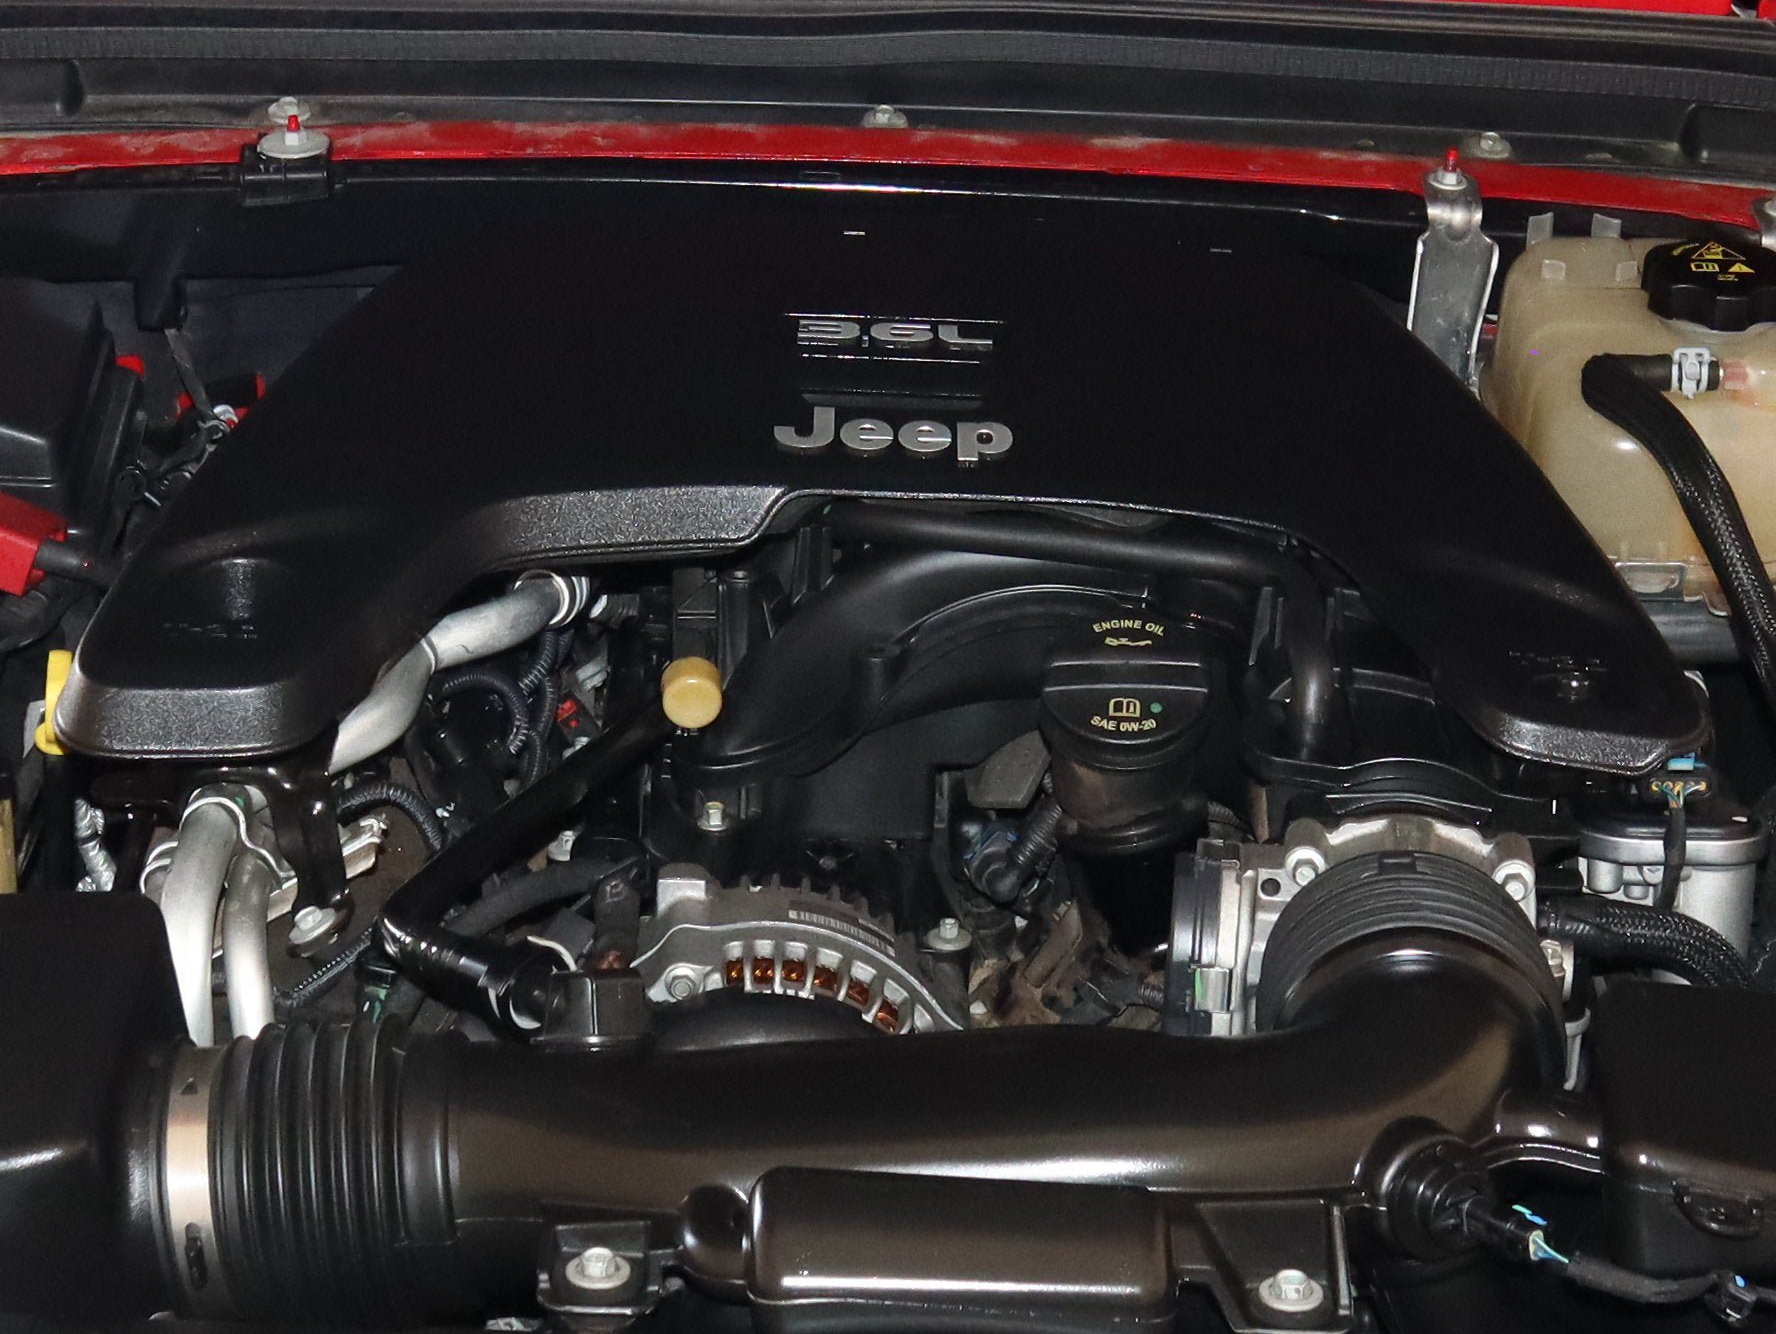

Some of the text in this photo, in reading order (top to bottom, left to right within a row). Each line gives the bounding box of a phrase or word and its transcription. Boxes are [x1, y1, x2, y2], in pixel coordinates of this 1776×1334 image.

[796, 319, 994, 348] 3.6L
[773, 405, 1014, 464] Jeep
[1092, 619, 1165, 636] ENGINE OIL
[1090, 715, 1157, 732] SAE 0W-20
